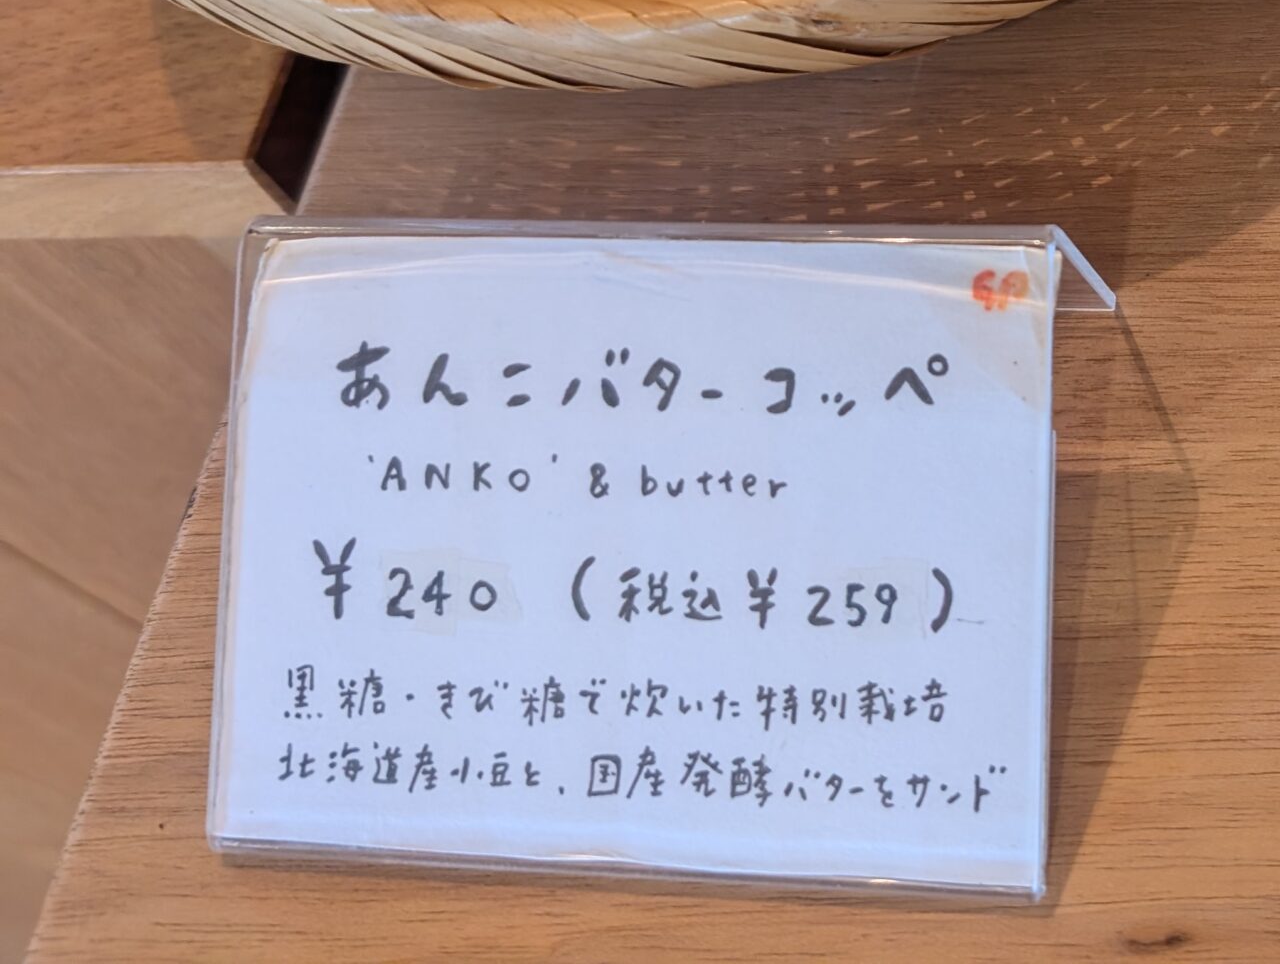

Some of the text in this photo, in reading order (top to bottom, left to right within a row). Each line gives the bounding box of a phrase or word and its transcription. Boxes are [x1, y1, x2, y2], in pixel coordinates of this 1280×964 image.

[335, 340, 950, 418] あんこバターコッペ
[589, 462, 610, 500] &
[640, 464, 788, 499] butter
[311, 536, 954, 634] ¥240 (税込¥259)
[283, 663, 948, 732] 黒糖・きび糖で炊いた特別栽培
[277, 741, 1007, 814] 北海道産小豆と、国産発酵バターをサンド
